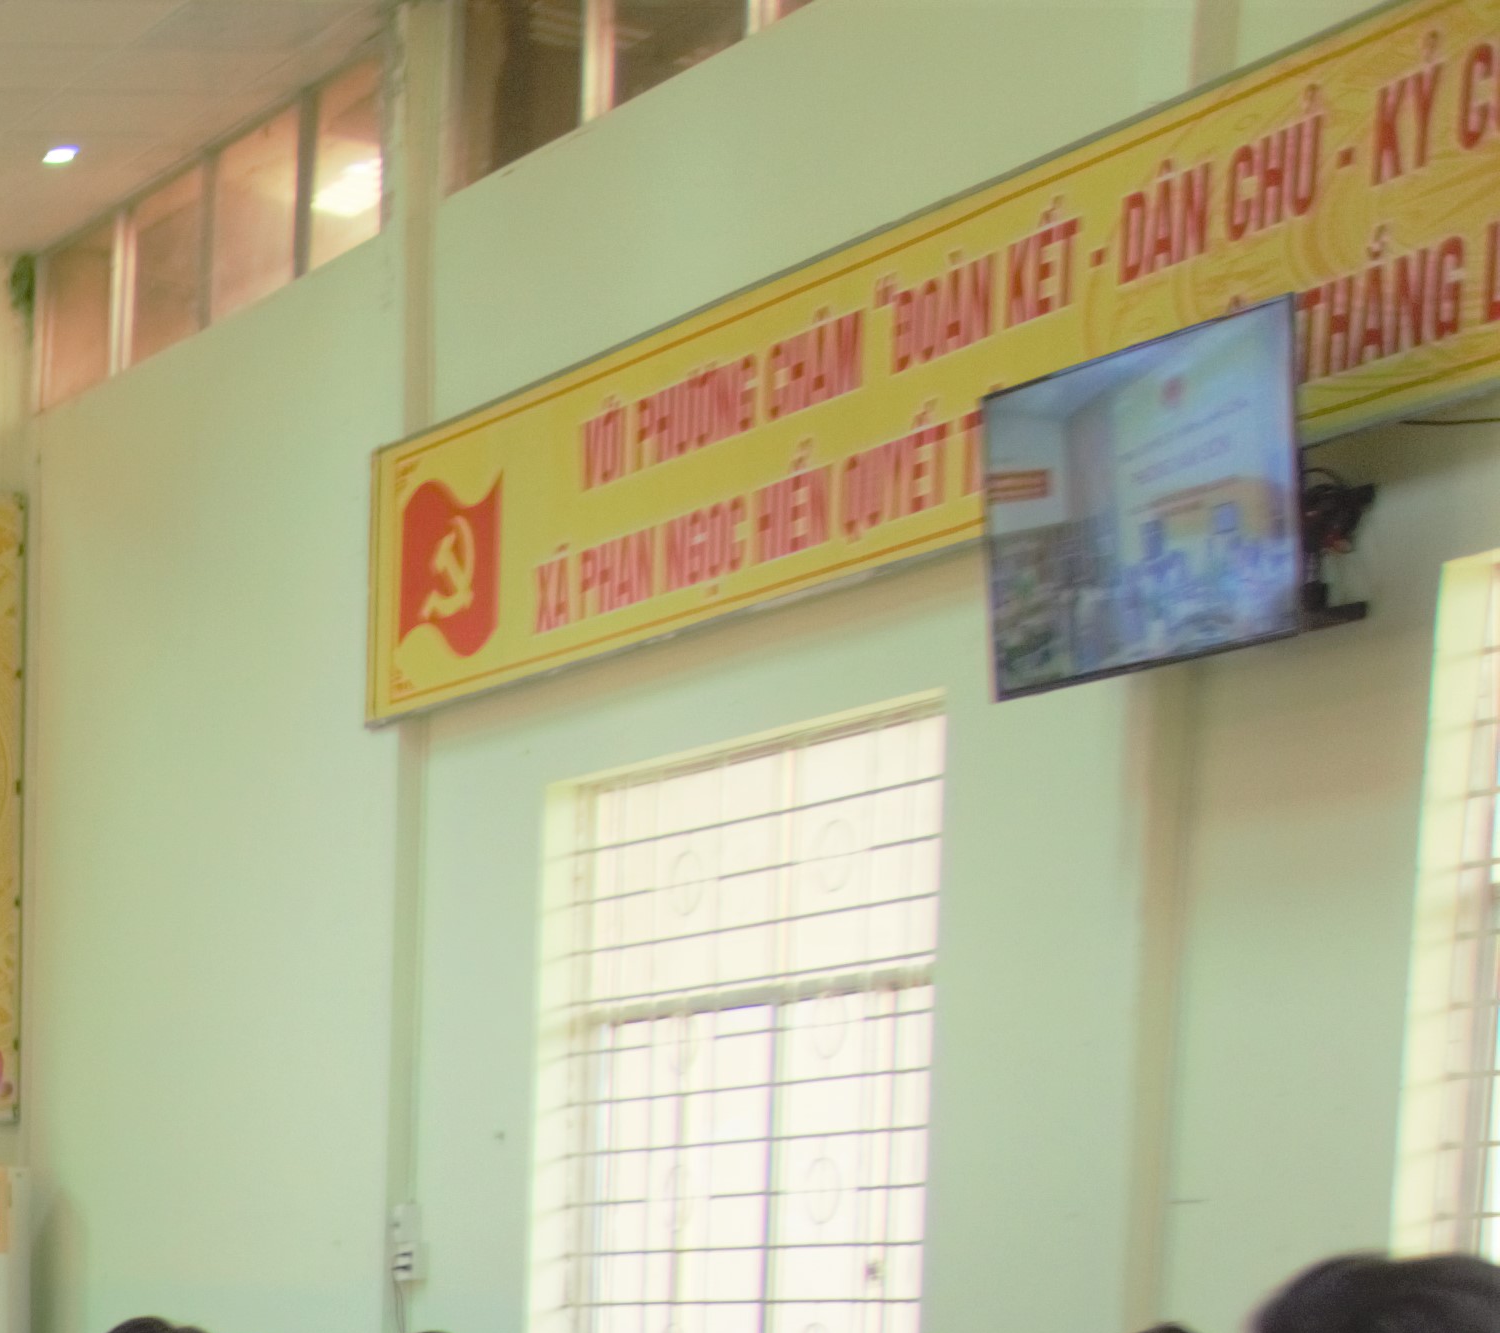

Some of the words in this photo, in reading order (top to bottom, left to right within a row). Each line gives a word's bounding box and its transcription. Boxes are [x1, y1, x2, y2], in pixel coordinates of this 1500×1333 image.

[578, 524, 656, 621] PHAN
[662, 494, 749, 598] NGỌC
[844, 397, 952, 544] QUYẾT
[1297, 223, 1465, 384] THẮNG
[582, 394, 628, 492] VỚI
[636, 353, 758, 474] PHƯƠNG
[769, 305, 865, 424] CHÂM
[1005, 195, 1081, 329] KẾT
[1118, 158, 1212, 286] DÂN
[1226, 83, 1326, 242] CHỦ
[1371, 30, 1445, 188] KỶ
